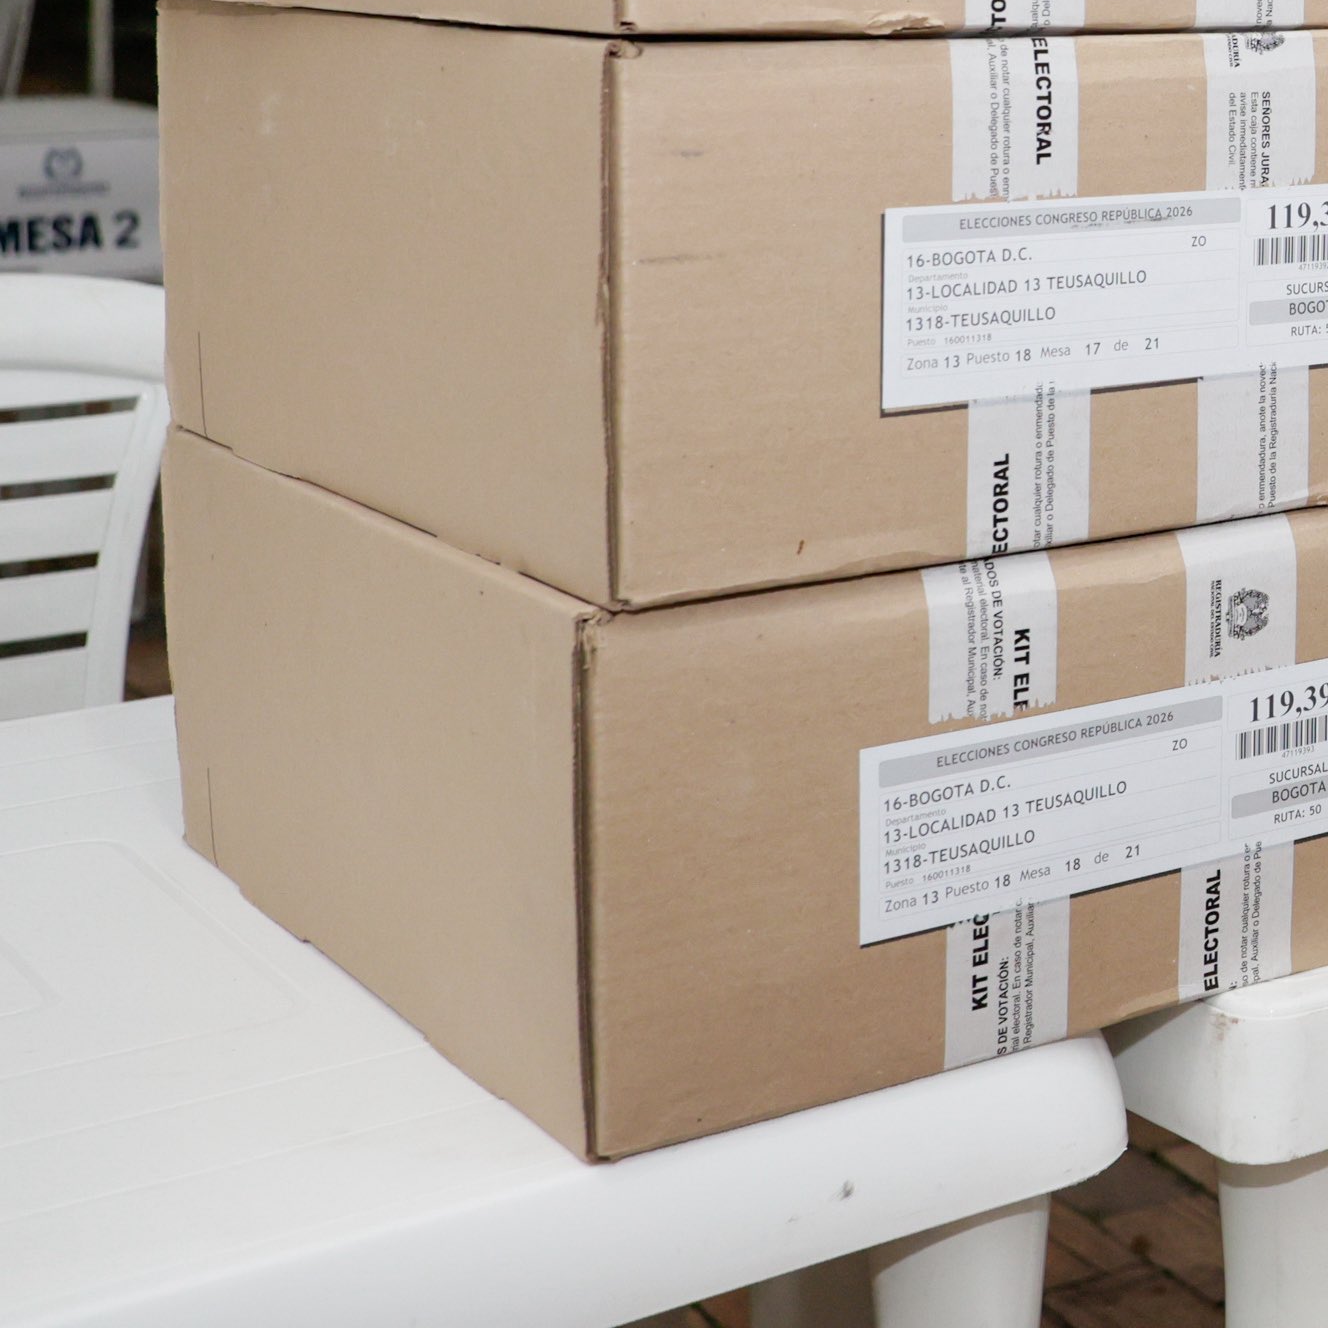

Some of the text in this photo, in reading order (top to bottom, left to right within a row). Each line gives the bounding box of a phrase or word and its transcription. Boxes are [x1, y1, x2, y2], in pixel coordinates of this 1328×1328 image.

[1002, 88, 1011, 132] cualquier
[1031, 38, 1051, 165] ELECTORAL
[1228, 109, 1237, 142] Estado
[1262, 92, 1272, 148] SEÑORES
[0, 209, 140, 253] MESA 2
[959, 205, 1192, 230] ELECCIONES CONGRESO REPÚBLICA 2026
[906, 247, 1032, 268] 16-BOGOTA D.C.
[906, 270, 1146, 300] 13-LOCALIDAD 13 TEUSAQUILLO
[908, 271, 968, 284] Departamento
[906, 307, 1055, 332] 1318-TEUSAQUILLO
[908, 303, 948, 315] Municipio
[943, 333, 992, 344] 160011318
[1290, 324, 1322, 337] RUTA:
[907, 337, 1159, 371] Zona 13 Puesto 18 Mesa 17 de 21
[1268, 387, 1278, 449] Registraduría
[1257, 434, 1267, 501] enmendadura,
[1034, 482, 1044, 530] cualquier
[1214, 580, 1223, 657] REGISTRADURÍA
[993, 610, 1005, 680] VOTACIÓN:
[1013, 629, 1030, 664] KIT
[965, 647, 976, 696] Municipal,
[936, 710, 1173, 768] ELECCIONES CONGRESO REPÚBLICA 2026
[1281, 745, 1315, 759] 47119393
[1268, 761, 1328, 785] SUCURSAL
[883, 773, 1011, 812] 16-BOGOTA D.C.
[1271, 780, 1327, 803] BOGOTA
[883, 780, 1127, 845] 13-LOCALIDAD 13 TEUSAQUILLO
[885, 807, 946, 828] Departamento
[1273, 802, 1321, 824] RUTA: 50
[883, 830, 1035, 876] 1318-TEUSAQUILLO
[885, 841, 926, 858] Municipio
[885, 844, 1140, 914] Zona 13 Puesto 18 Mesa 18 de 21
[922, 864, 970, 883] 160011318
[1204, 870, 1221, 991] ELECTORAL
[1251, 928, 1260, 961] Auxiliar
[972, 974, 988, 1010] KIT
[998, 957, 1010, 1023] VOTACIÓN:
[1024, 990, 1034, 1043] Registrador
